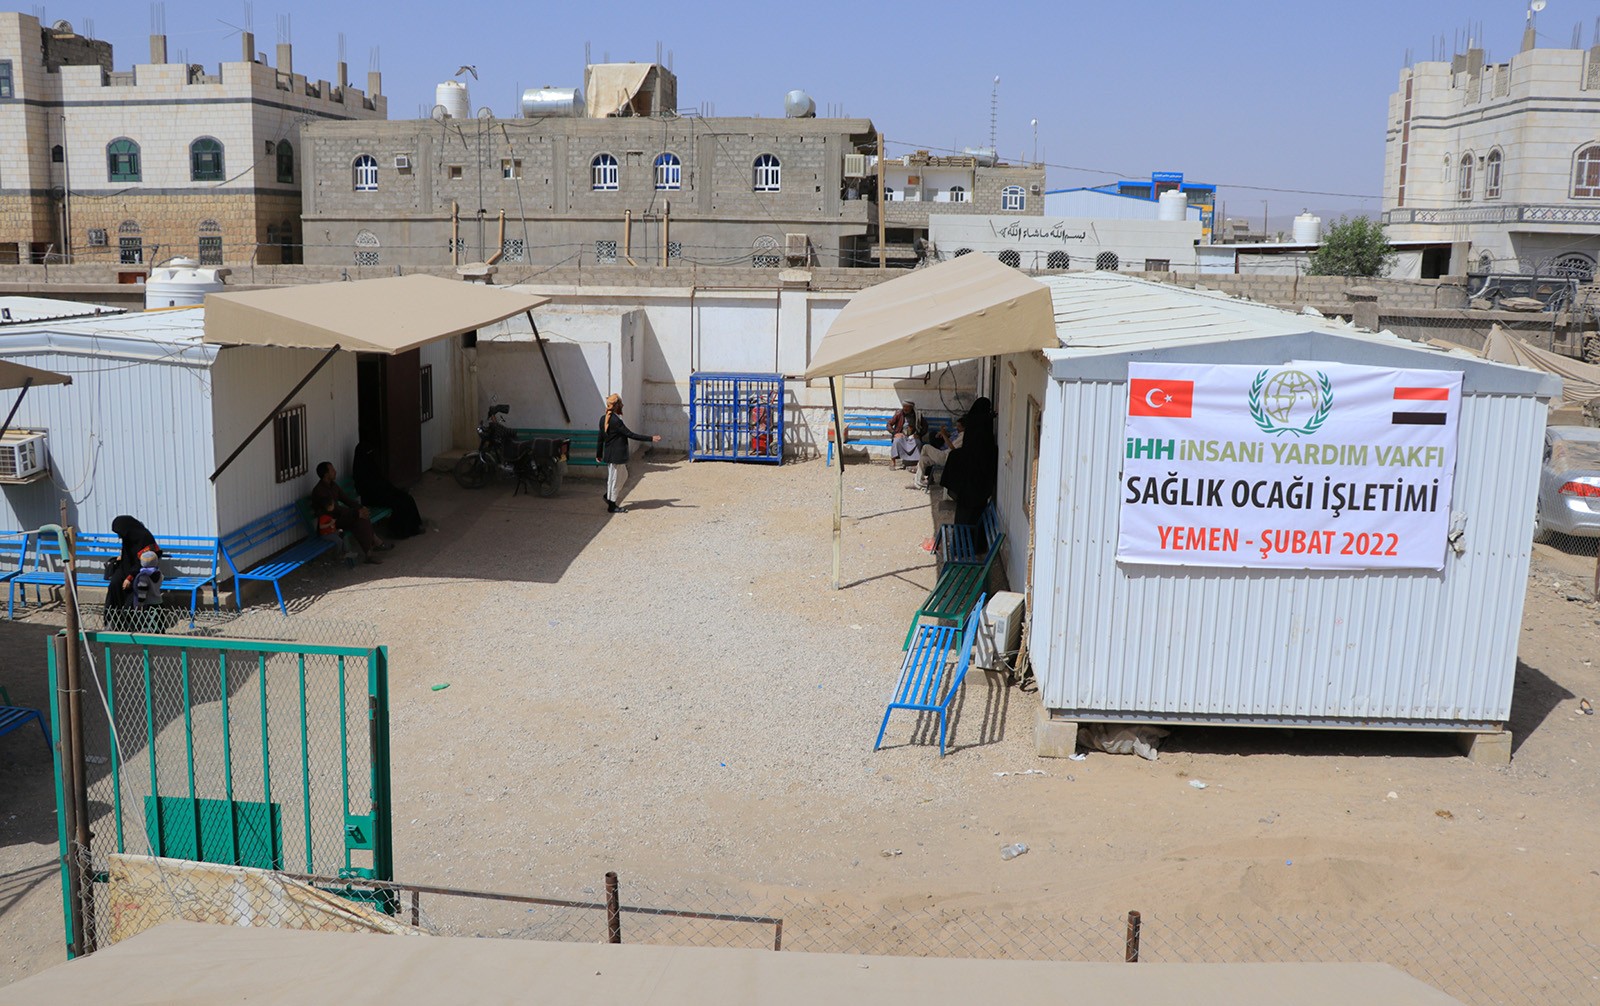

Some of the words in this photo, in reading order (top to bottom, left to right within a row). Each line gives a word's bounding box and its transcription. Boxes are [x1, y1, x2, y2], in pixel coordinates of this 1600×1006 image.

[1064, 231, 1087, 244] بسم
[1271, 443, 1368, 465] YARDIM
[1375, 446, 1444, 467] VAKFI
[1126, 472, 1224, 506] SAĞLIK
[1232, 476, 1313, 509] OCAĞI
[1322, 476, 1438, 518] İŞLETİMİ
[1158, 526, 1238, 551] YEMEN
[1260, 530, 1336, 558] ŞUBAT
[1341, 532, 1398, 556] 2022
